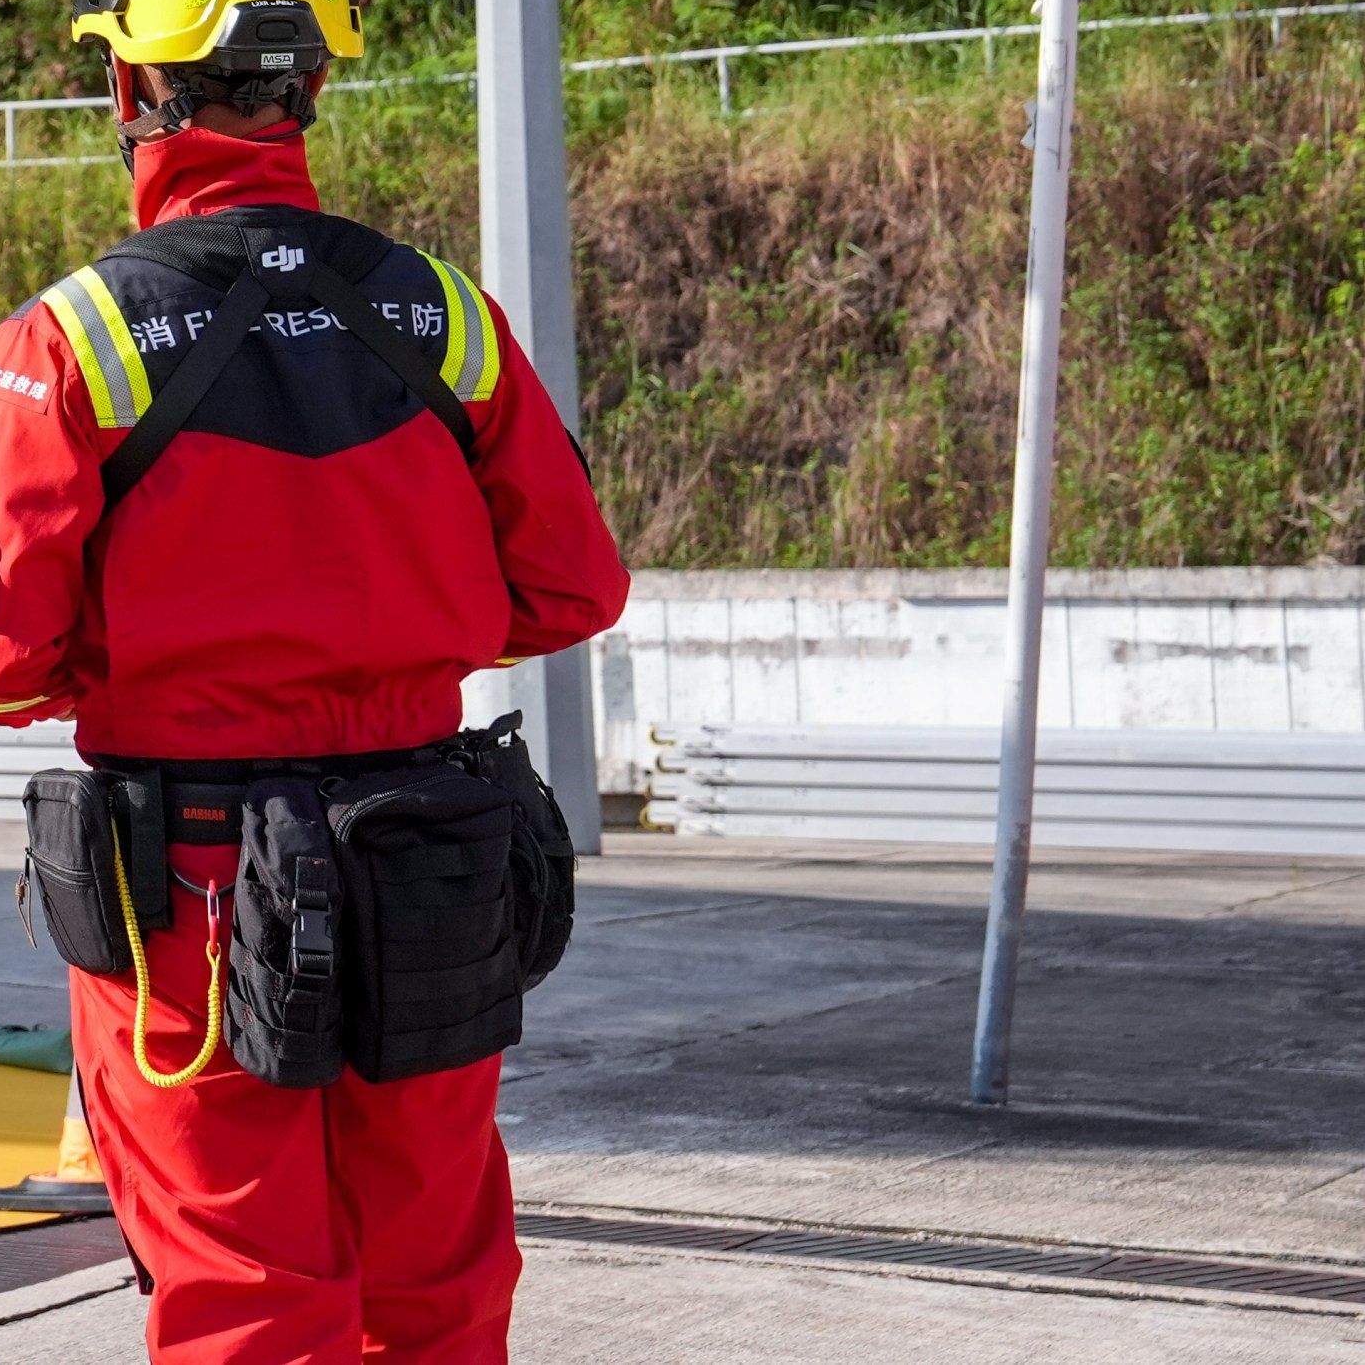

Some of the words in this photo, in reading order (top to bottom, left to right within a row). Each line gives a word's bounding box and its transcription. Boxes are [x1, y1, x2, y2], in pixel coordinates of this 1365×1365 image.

[262, 55, 292, 64] MSA
[131, 316, 177, 353] 消
[411, 303, 443, 337] 防
